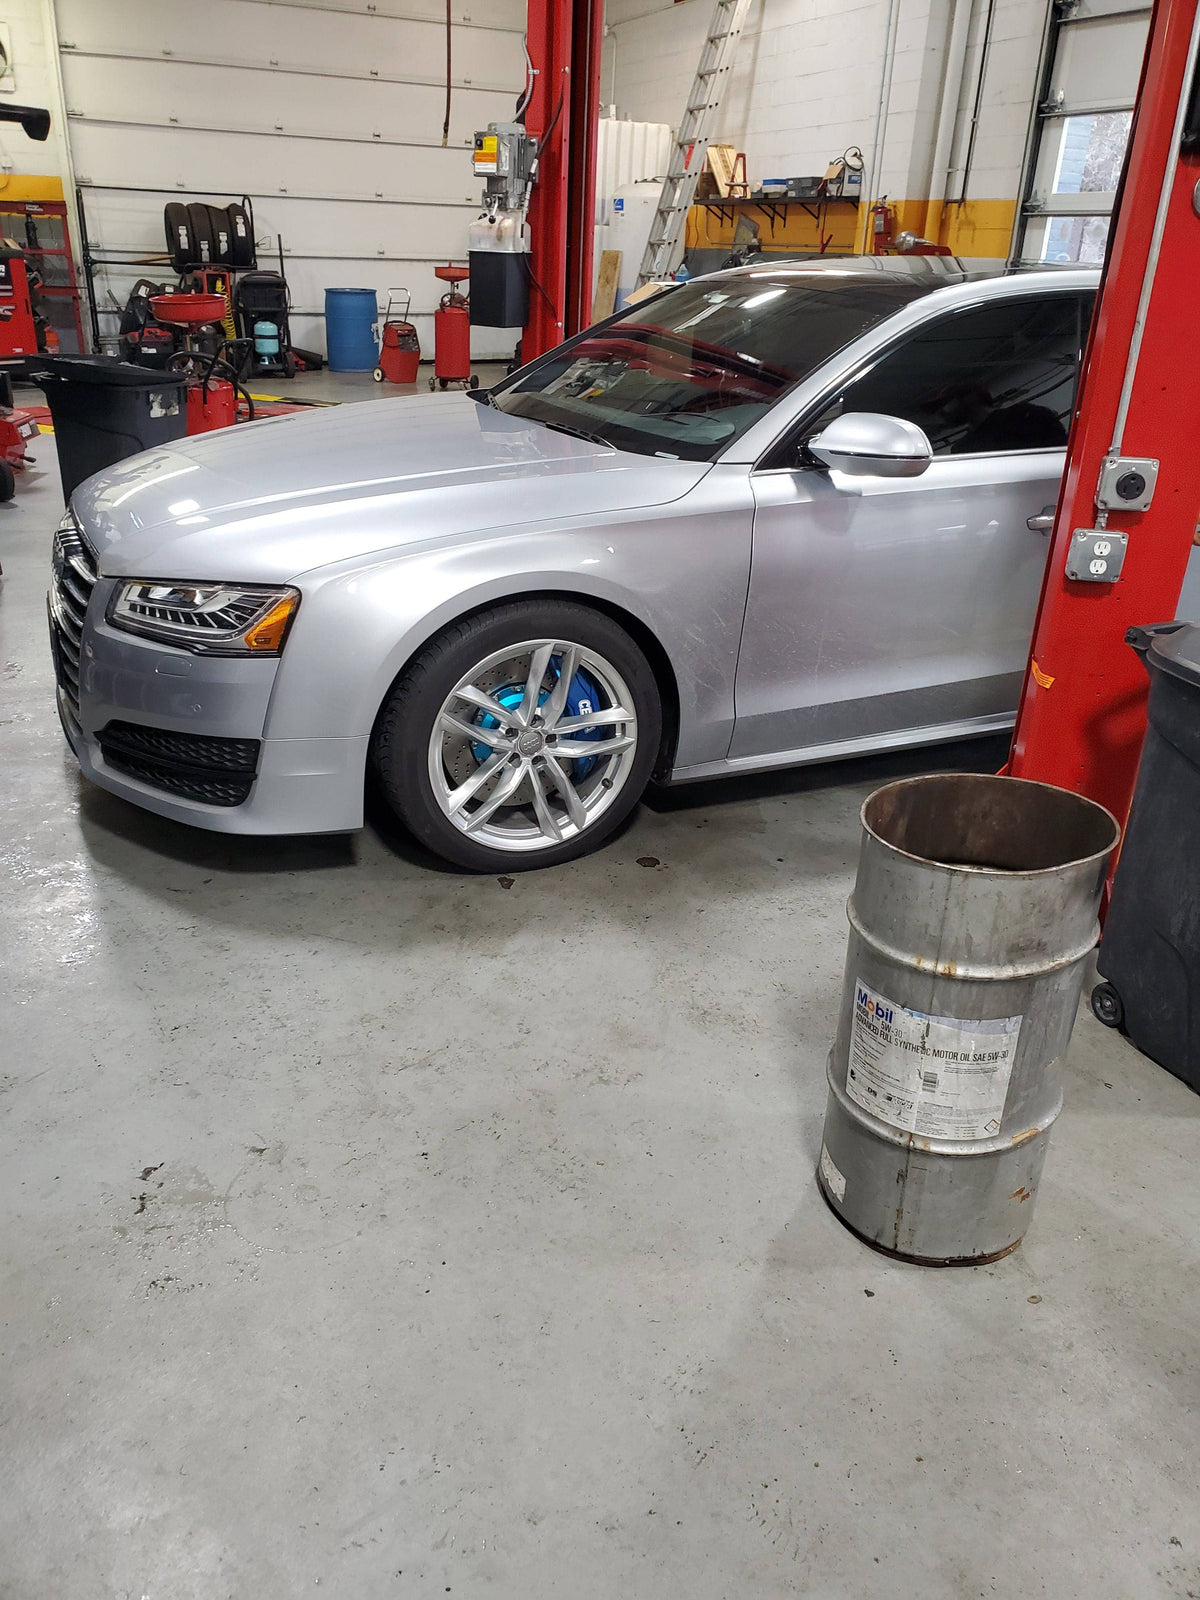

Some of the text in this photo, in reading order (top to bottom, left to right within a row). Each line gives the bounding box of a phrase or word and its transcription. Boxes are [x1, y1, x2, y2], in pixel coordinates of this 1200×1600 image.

[857, 987, 893, 1024] Mobil
[855, 1011, 880, 1036] ADVANCED
[879, 1029, 893, 1045] FULL
[932, 1048, 959, 1061] MOTOR
[960, 1052, 971, 1062] OIL
[972, 1052, 986, 1063] SAE
[987, 1049, 1009, 1061] 5W-30
[880, 1020, 903, 1039] 5W-30
